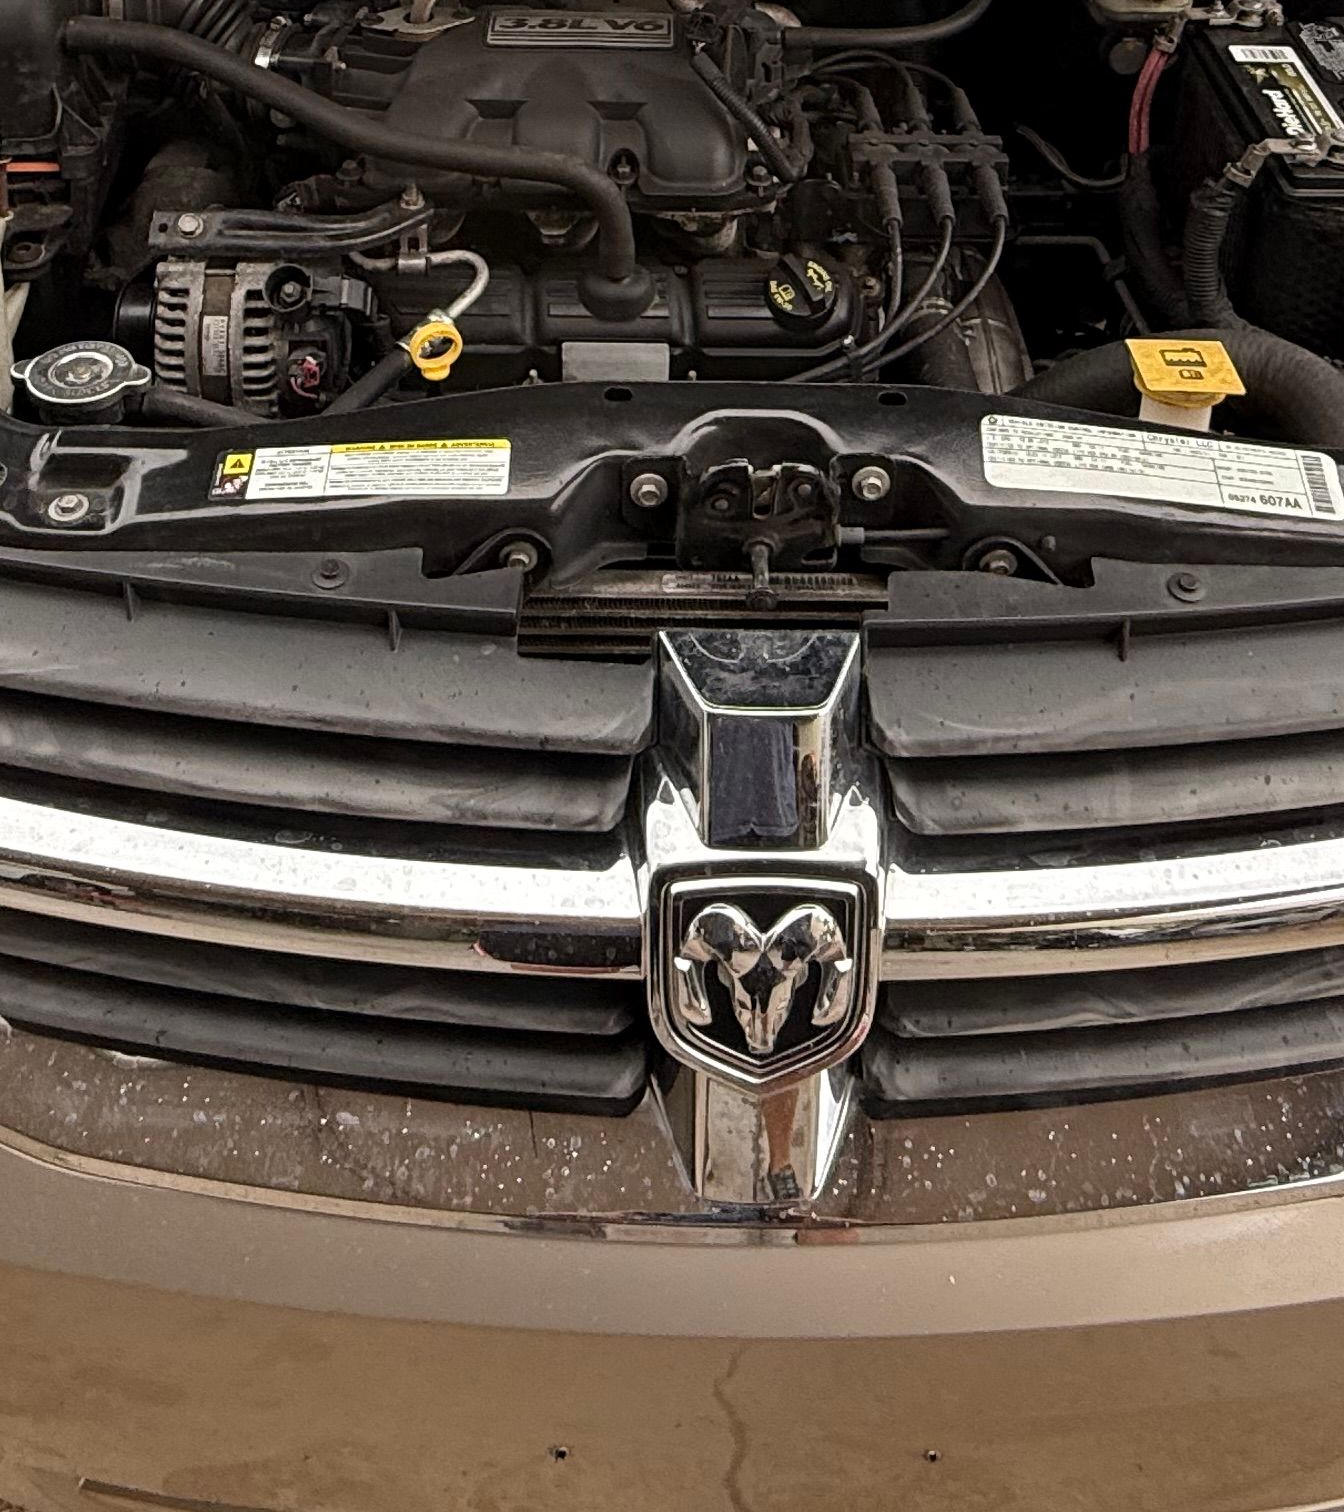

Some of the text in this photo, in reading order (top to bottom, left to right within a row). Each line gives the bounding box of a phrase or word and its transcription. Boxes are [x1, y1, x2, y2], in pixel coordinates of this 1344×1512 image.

[498, 17, 665, 32] 3.8L V6
[1259, 494, 1303, 510] 607AA
